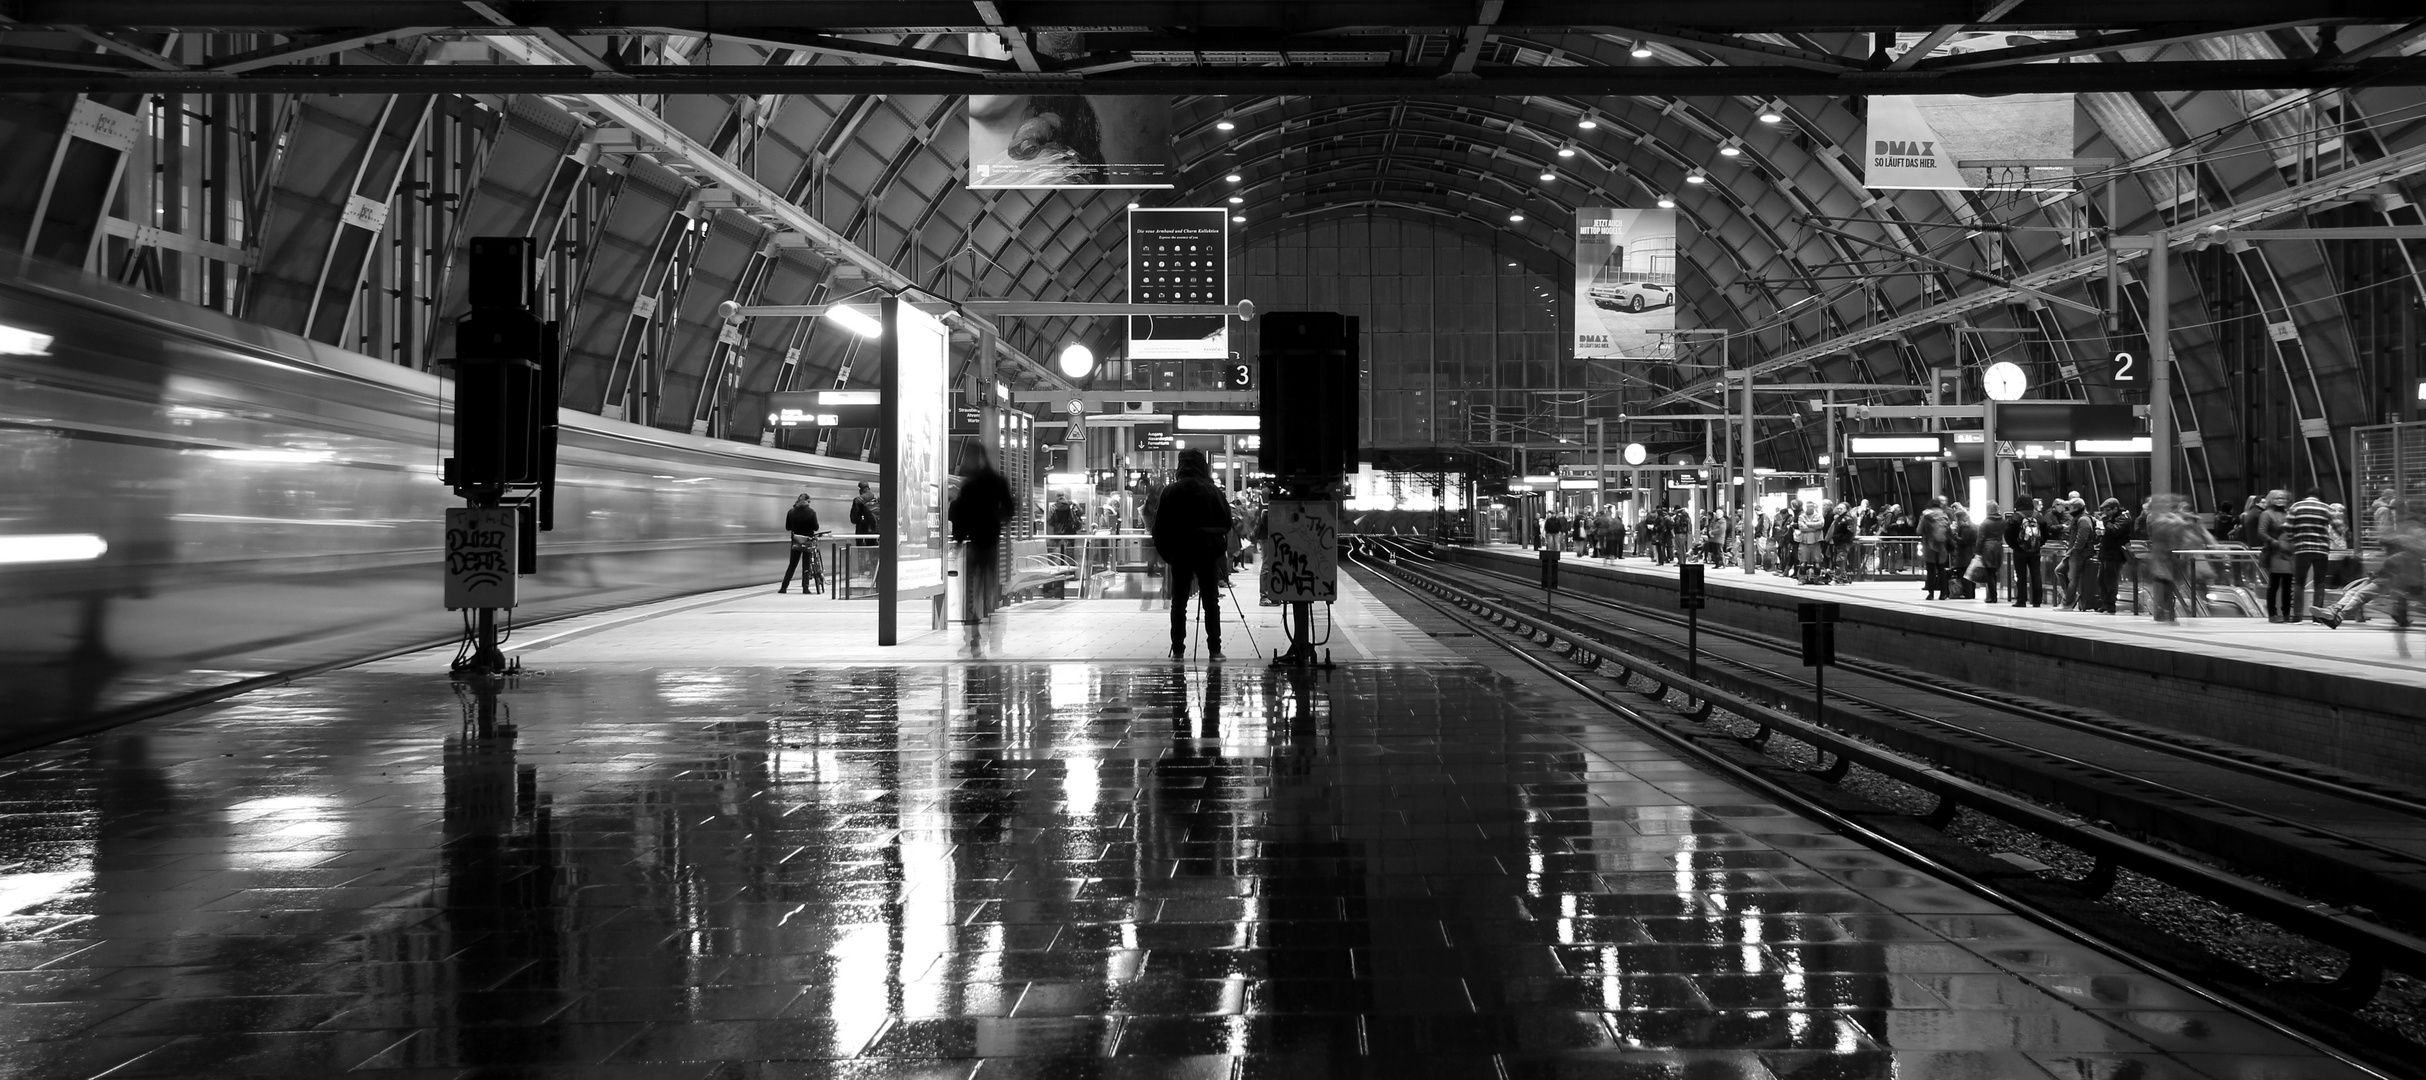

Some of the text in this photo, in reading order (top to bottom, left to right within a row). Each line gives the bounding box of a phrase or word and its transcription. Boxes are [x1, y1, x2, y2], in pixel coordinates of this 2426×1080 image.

[1875, 141, 1934, 156] DMAX
[1874, 156, 1936, 168] SO LÄUFT DAS HIER.
[1236, 365, 1249, 385] 3
[2115, 353, 2133, 380] 2
